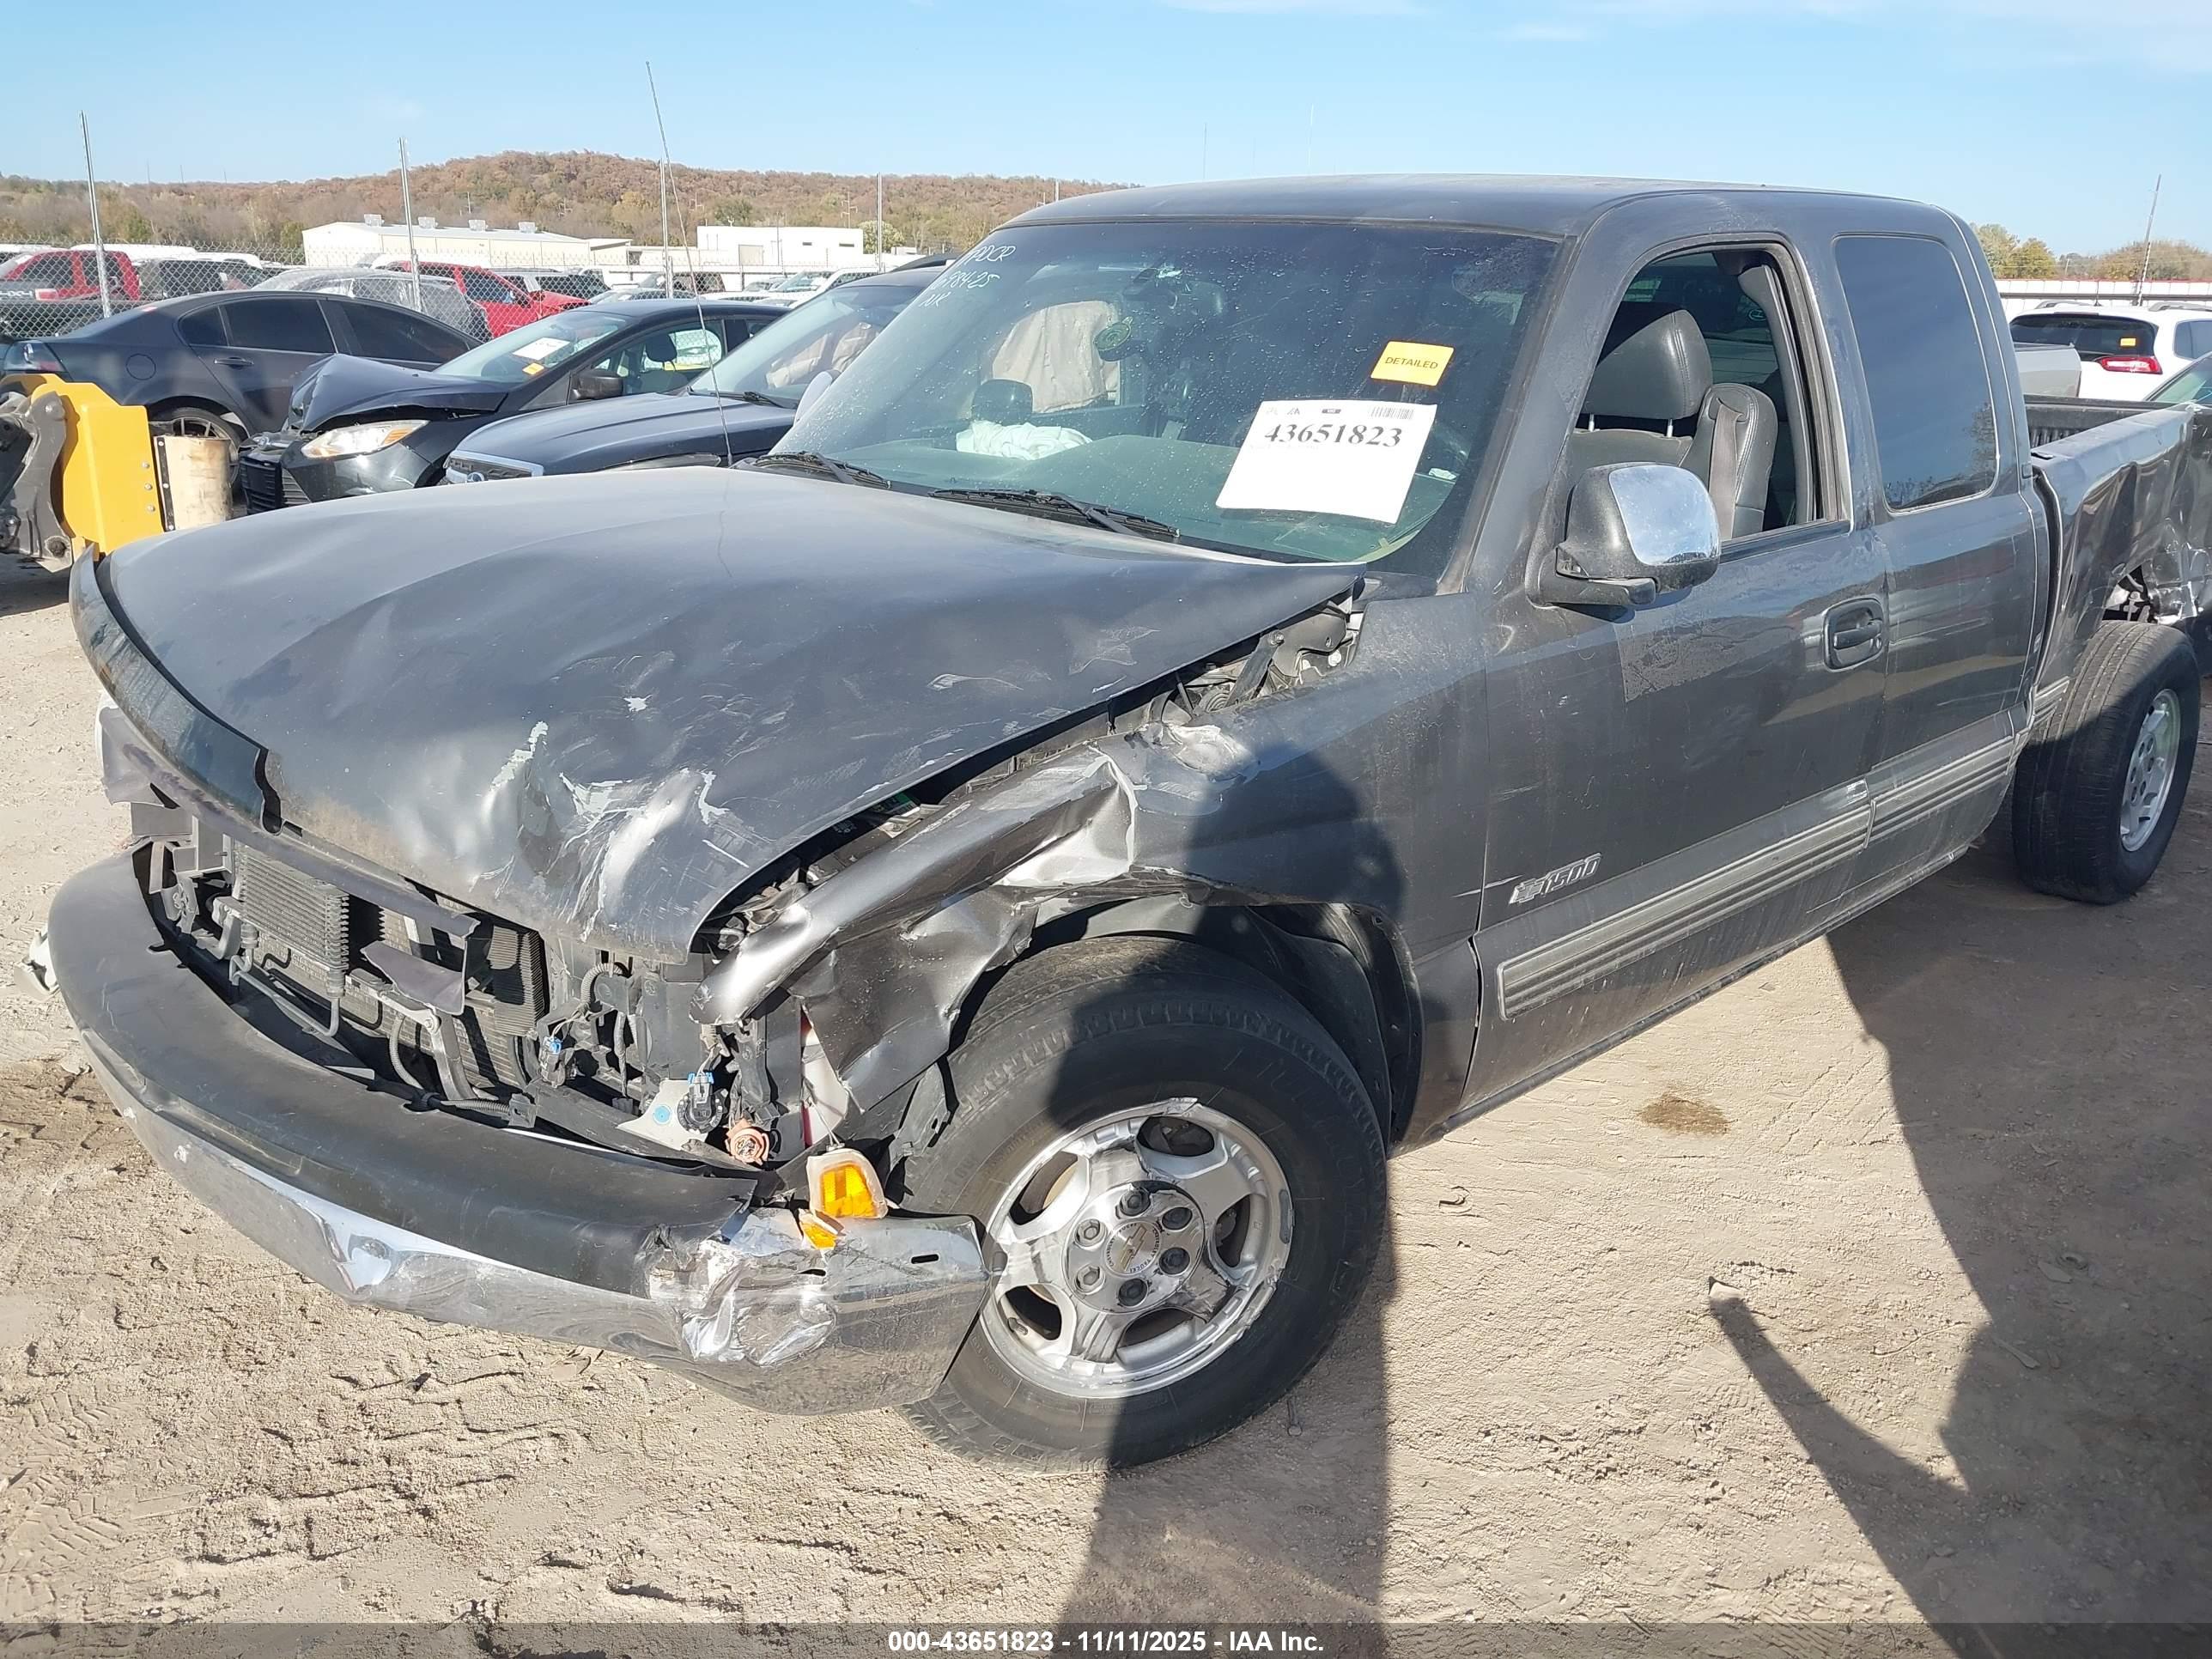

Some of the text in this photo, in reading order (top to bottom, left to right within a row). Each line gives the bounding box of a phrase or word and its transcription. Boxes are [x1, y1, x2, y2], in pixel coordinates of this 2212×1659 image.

[1384, 356, 1438, 370] DETAILED
[1264, 423, 1403, 447] 43651823
[1542, 853, 1601, 896] 1500
